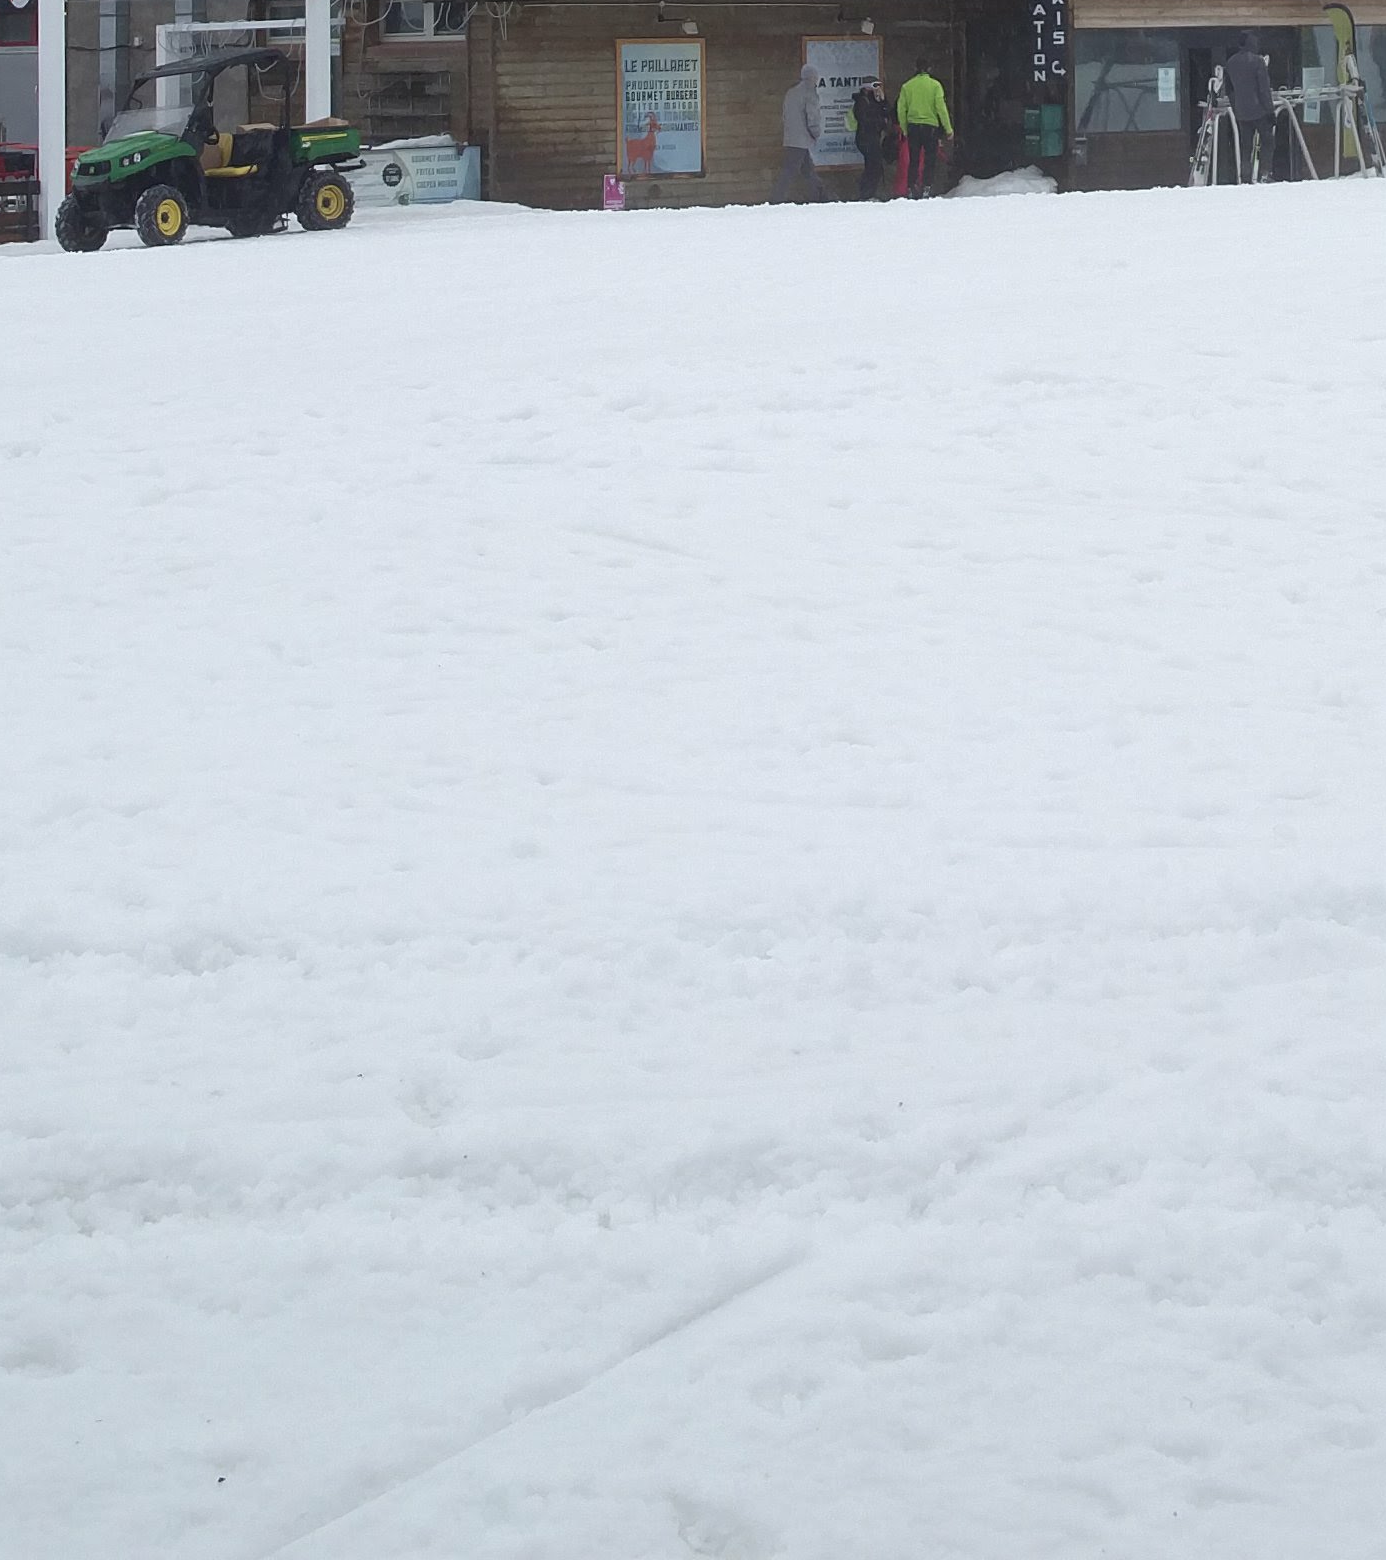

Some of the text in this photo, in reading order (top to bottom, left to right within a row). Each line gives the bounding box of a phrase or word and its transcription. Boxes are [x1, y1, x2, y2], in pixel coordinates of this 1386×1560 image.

[625, 59, 698, 73] LE PAILLARET
[626, 90, 698, 101] GOURMET BURGERS
